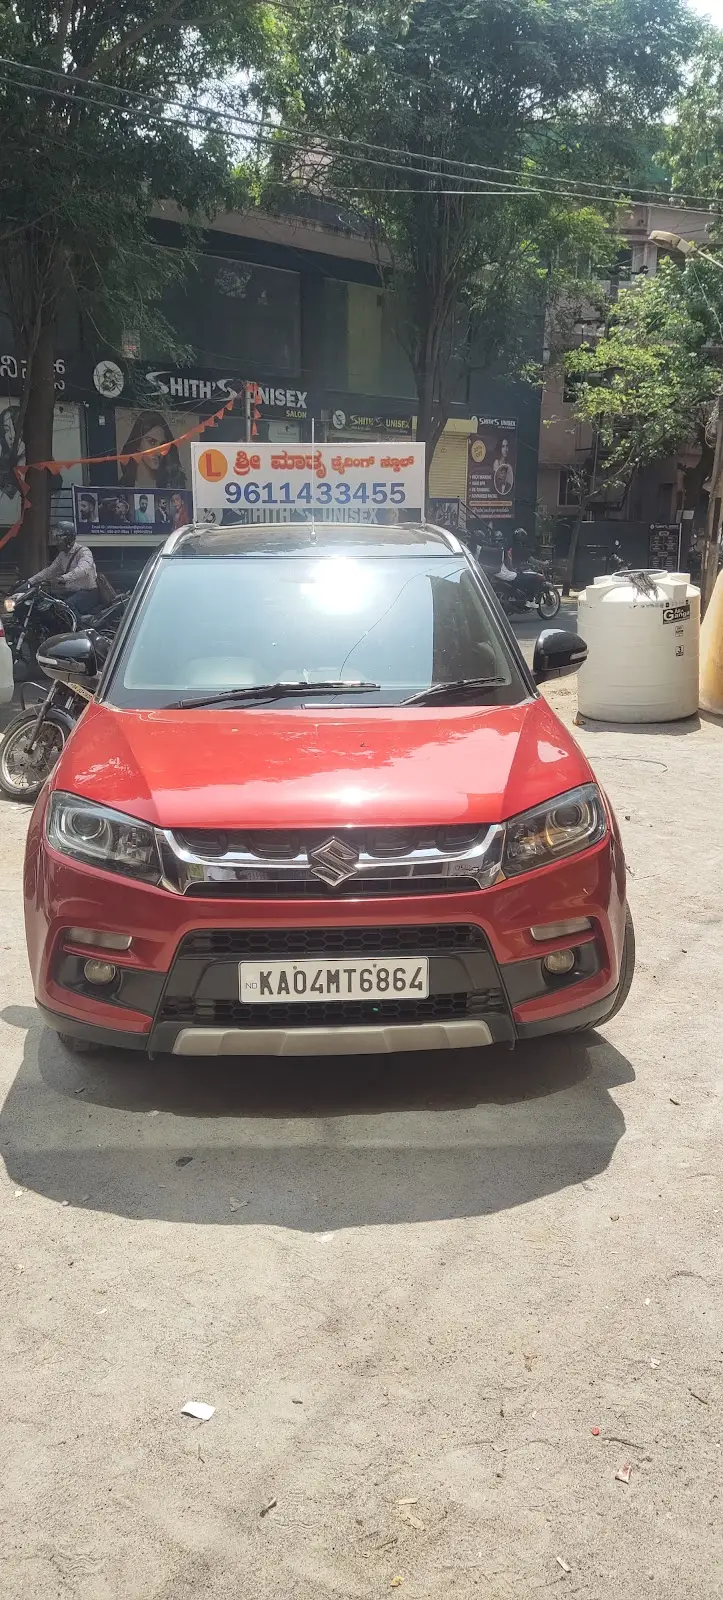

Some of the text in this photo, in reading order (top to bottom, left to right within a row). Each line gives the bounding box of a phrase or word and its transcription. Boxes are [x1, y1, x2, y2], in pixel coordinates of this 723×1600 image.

[145, 371, 238, 402] SHITH'S
[286, 410, 308, 420] SALON
[233, 450, 261, 476] ಶ್ರೀ
[224, 482, 406, 505] 9611433455
[322, 508, 379, 524] UNISEX
[259, 966, 423, 996] KA04MT6864
